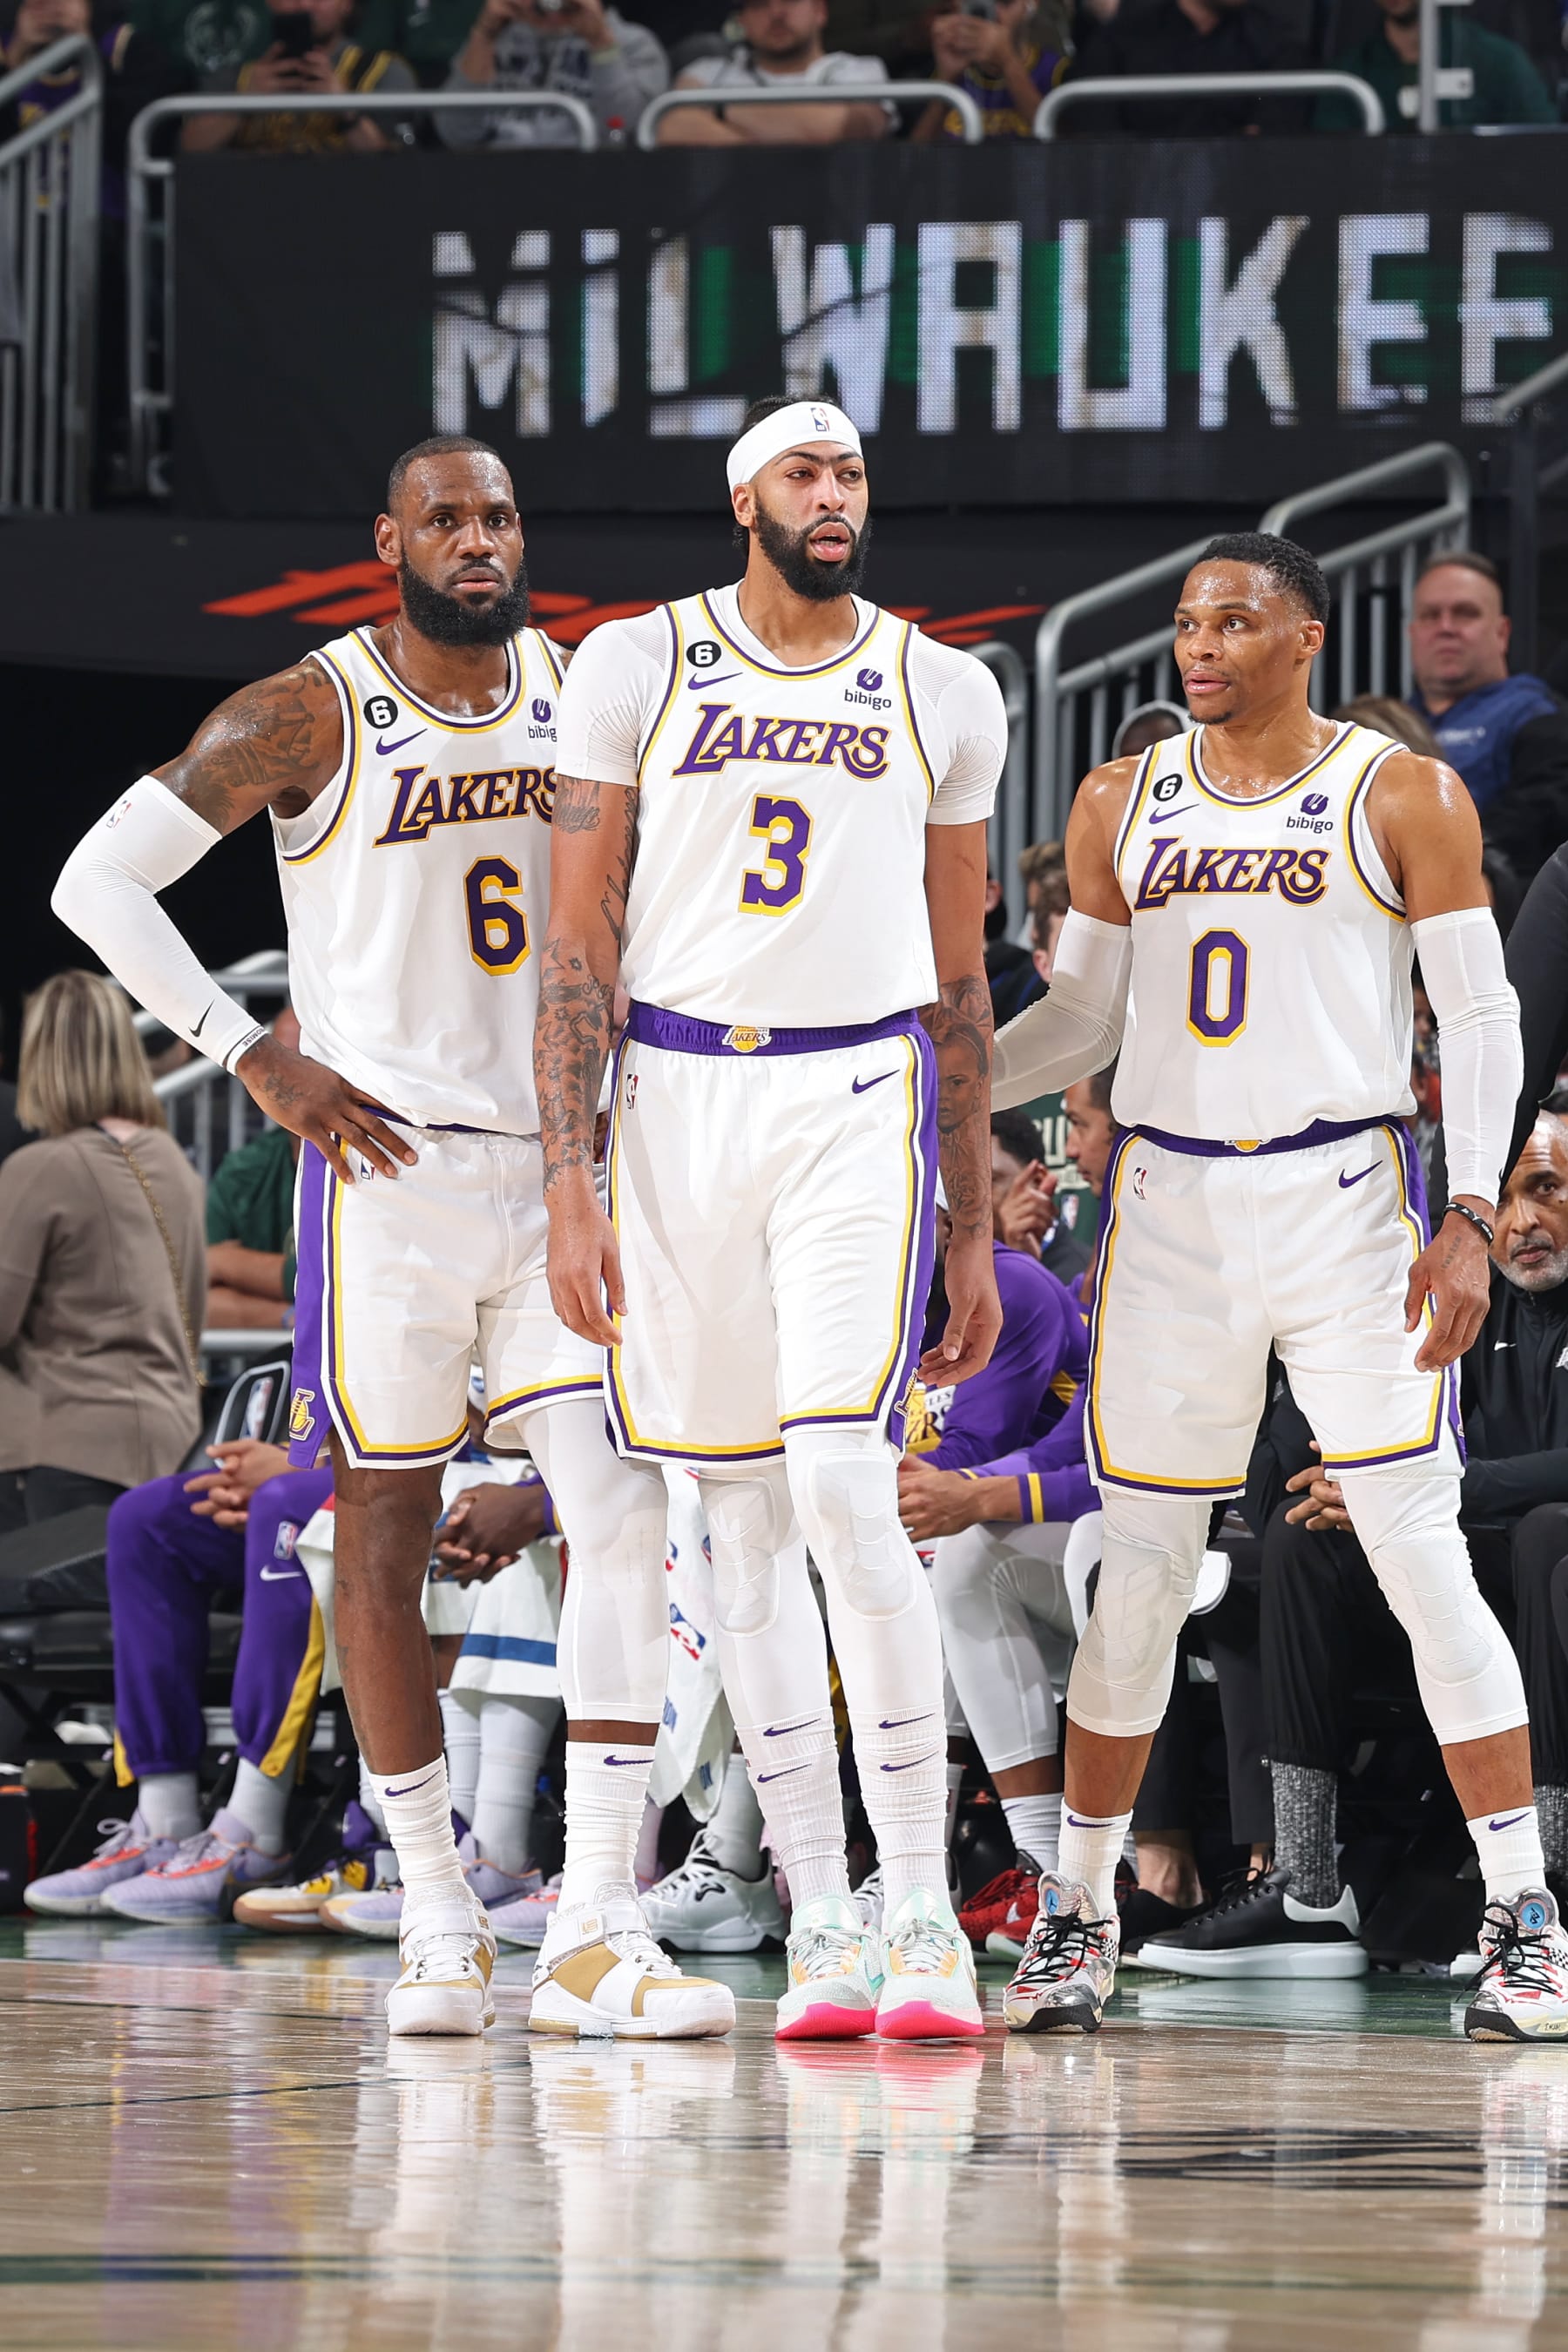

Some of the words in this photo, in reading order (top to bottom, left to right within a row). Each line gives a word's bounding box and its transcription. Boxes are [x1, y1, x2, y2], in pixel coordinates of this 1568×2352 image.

[695, 644, 713, 665] 6
[844, 688, 892, 711] bibigo
[371, 700, 391, 725] 6
[527, 724, 558, 742] bibig
[669, 702, 892, 781] LAKERS
[1159, 777, 1178, 799] 6
[1286, 816, 1334, 834] bibigo
[738, 793, 814, 917] 3
[1132, 835, 1333, 913] LAKERS
[463, 854, 532, 977] 6
[1186, 928, 1251, 1048] 0
